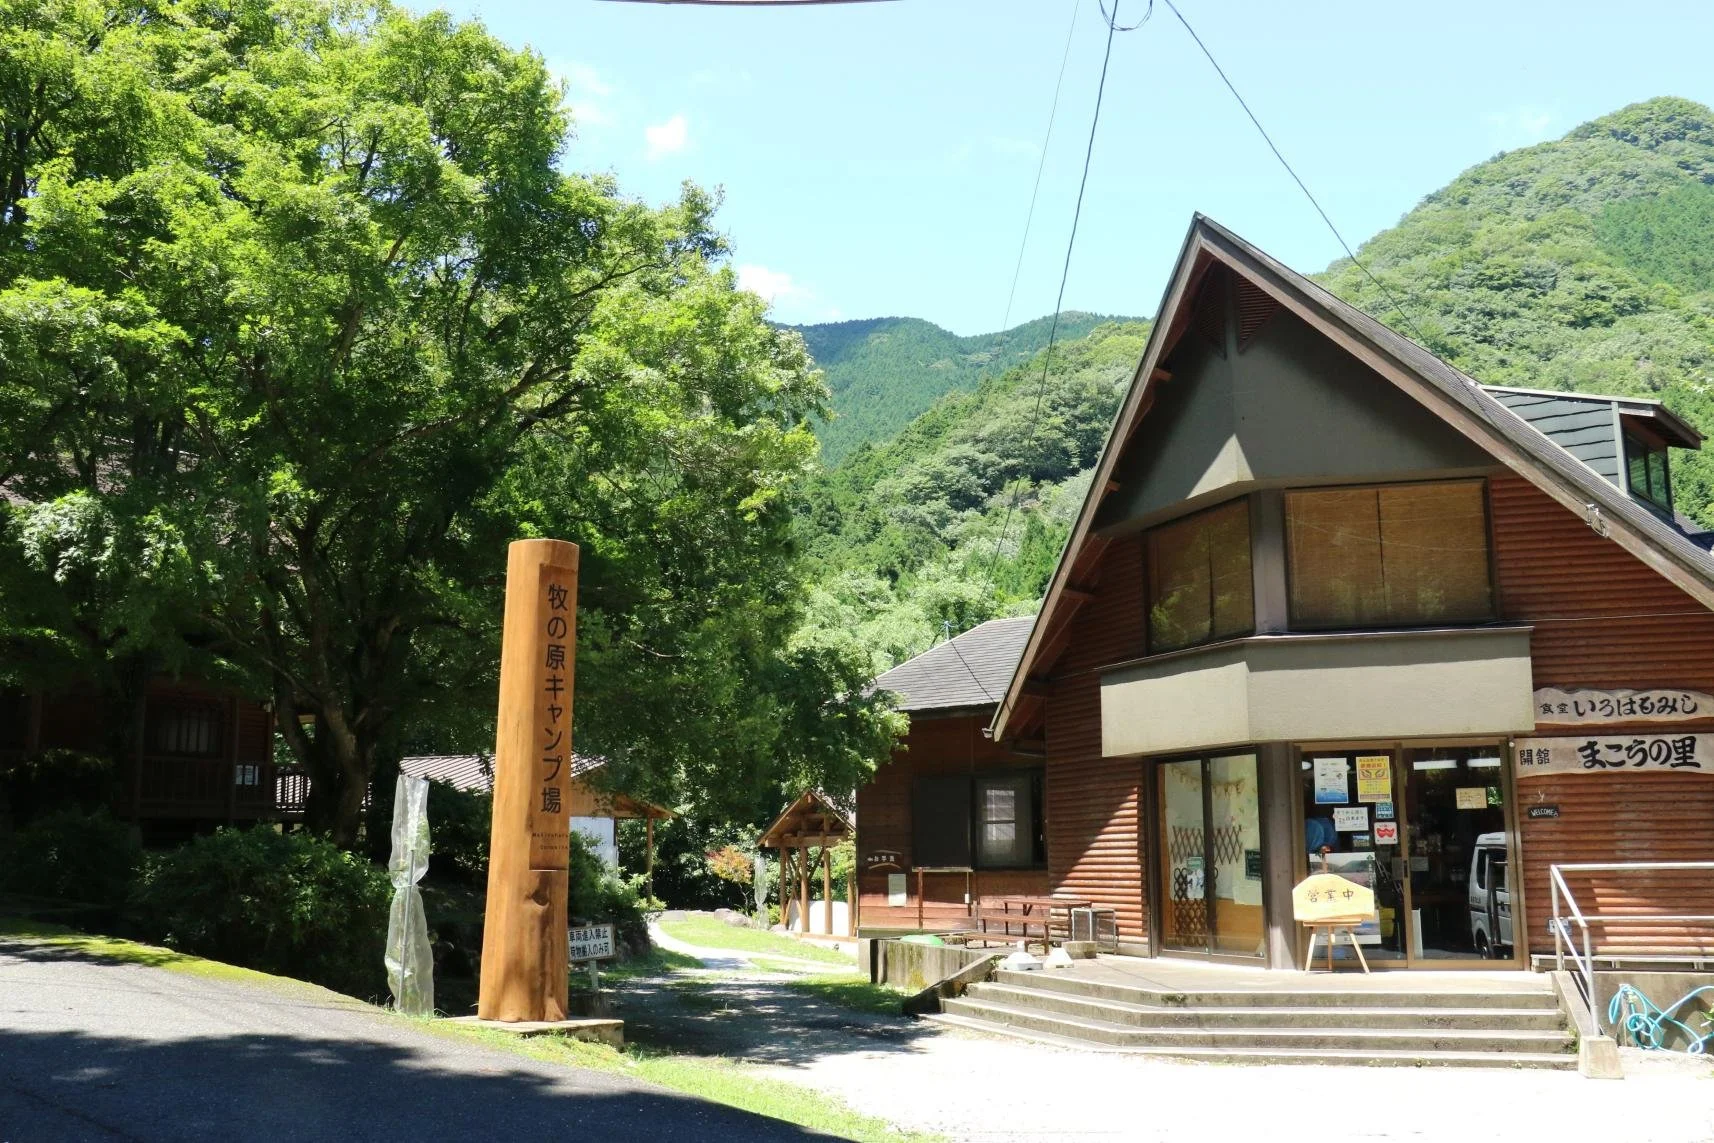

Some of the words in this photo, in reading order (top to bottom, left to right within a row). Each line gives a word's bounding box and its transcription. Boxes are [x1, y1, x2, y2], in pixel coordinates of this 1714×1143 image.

[541, 583, 569, 814] 牧の原キャンプ場
[1540, 702, 1569, 715] 食堂
[1573, 694, 1698, 717] いろはもみじ
[1306, 887, 1355, 903] 営業中
[569, 928, 609, 942] 車両進入禁止
